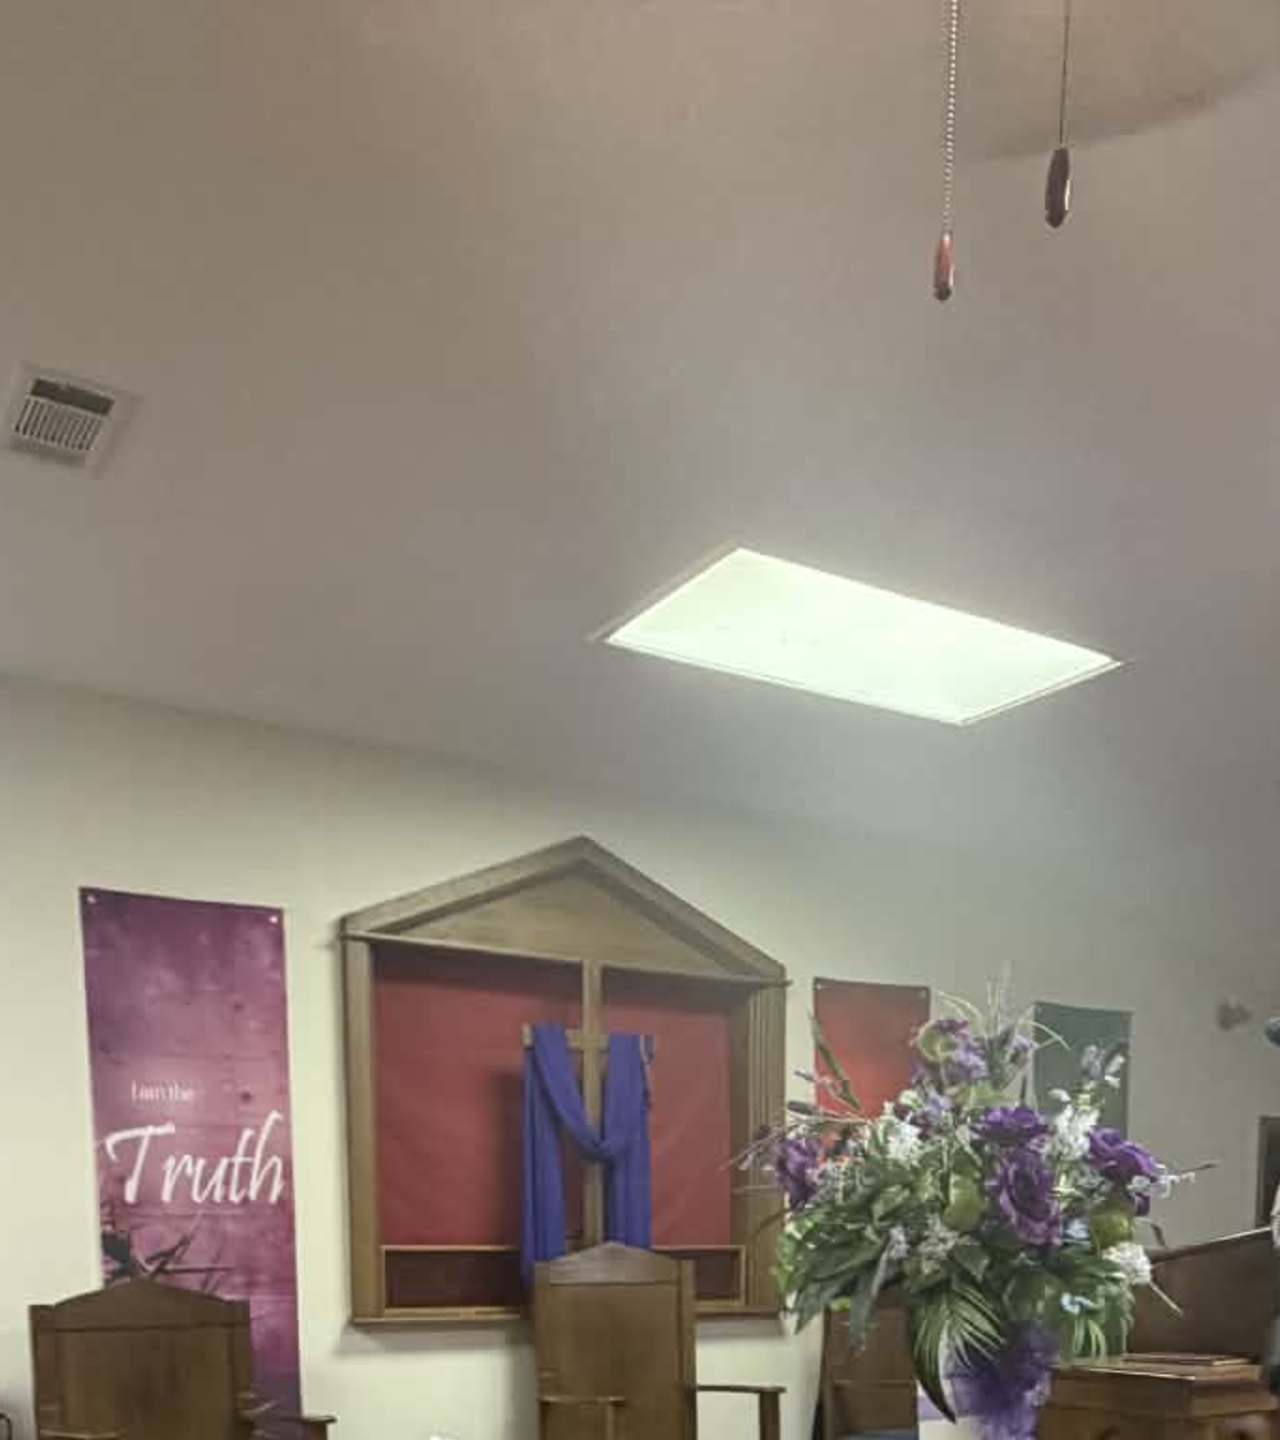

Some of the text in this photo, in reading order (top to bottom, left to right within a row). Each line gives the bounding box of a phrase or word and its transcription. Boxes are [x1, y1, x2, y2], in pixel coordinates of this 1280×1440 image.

[140, 1086, 166, 1101] am
[168, 1082, 195, 1101] the
[105, 1110, 284, 1204] Truth
